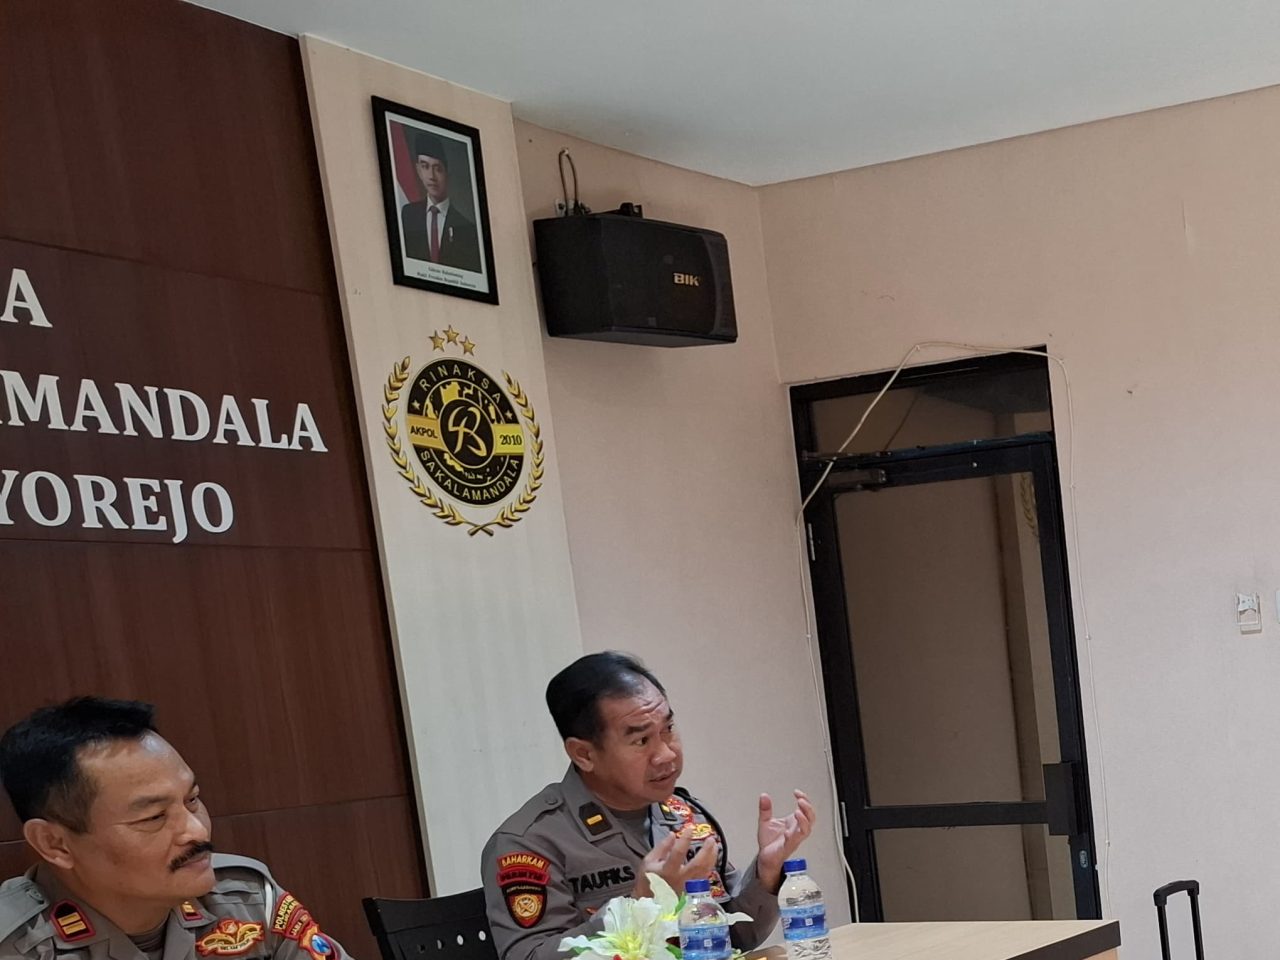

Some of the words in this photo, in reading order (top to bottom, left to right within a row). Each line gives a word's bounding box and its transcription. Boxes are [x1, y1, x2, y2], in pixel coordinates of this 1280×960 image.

[673, 272, 700, 287] BIK
[419, 363, 501, 404] RINAKSA
[0, 369, 328, 452] MANDALA
[410, 425, 438, 439] AKPOL
[500, 434, 522, 446] 2010
[420, 450, 520, 501] SAKALAMANDALA
